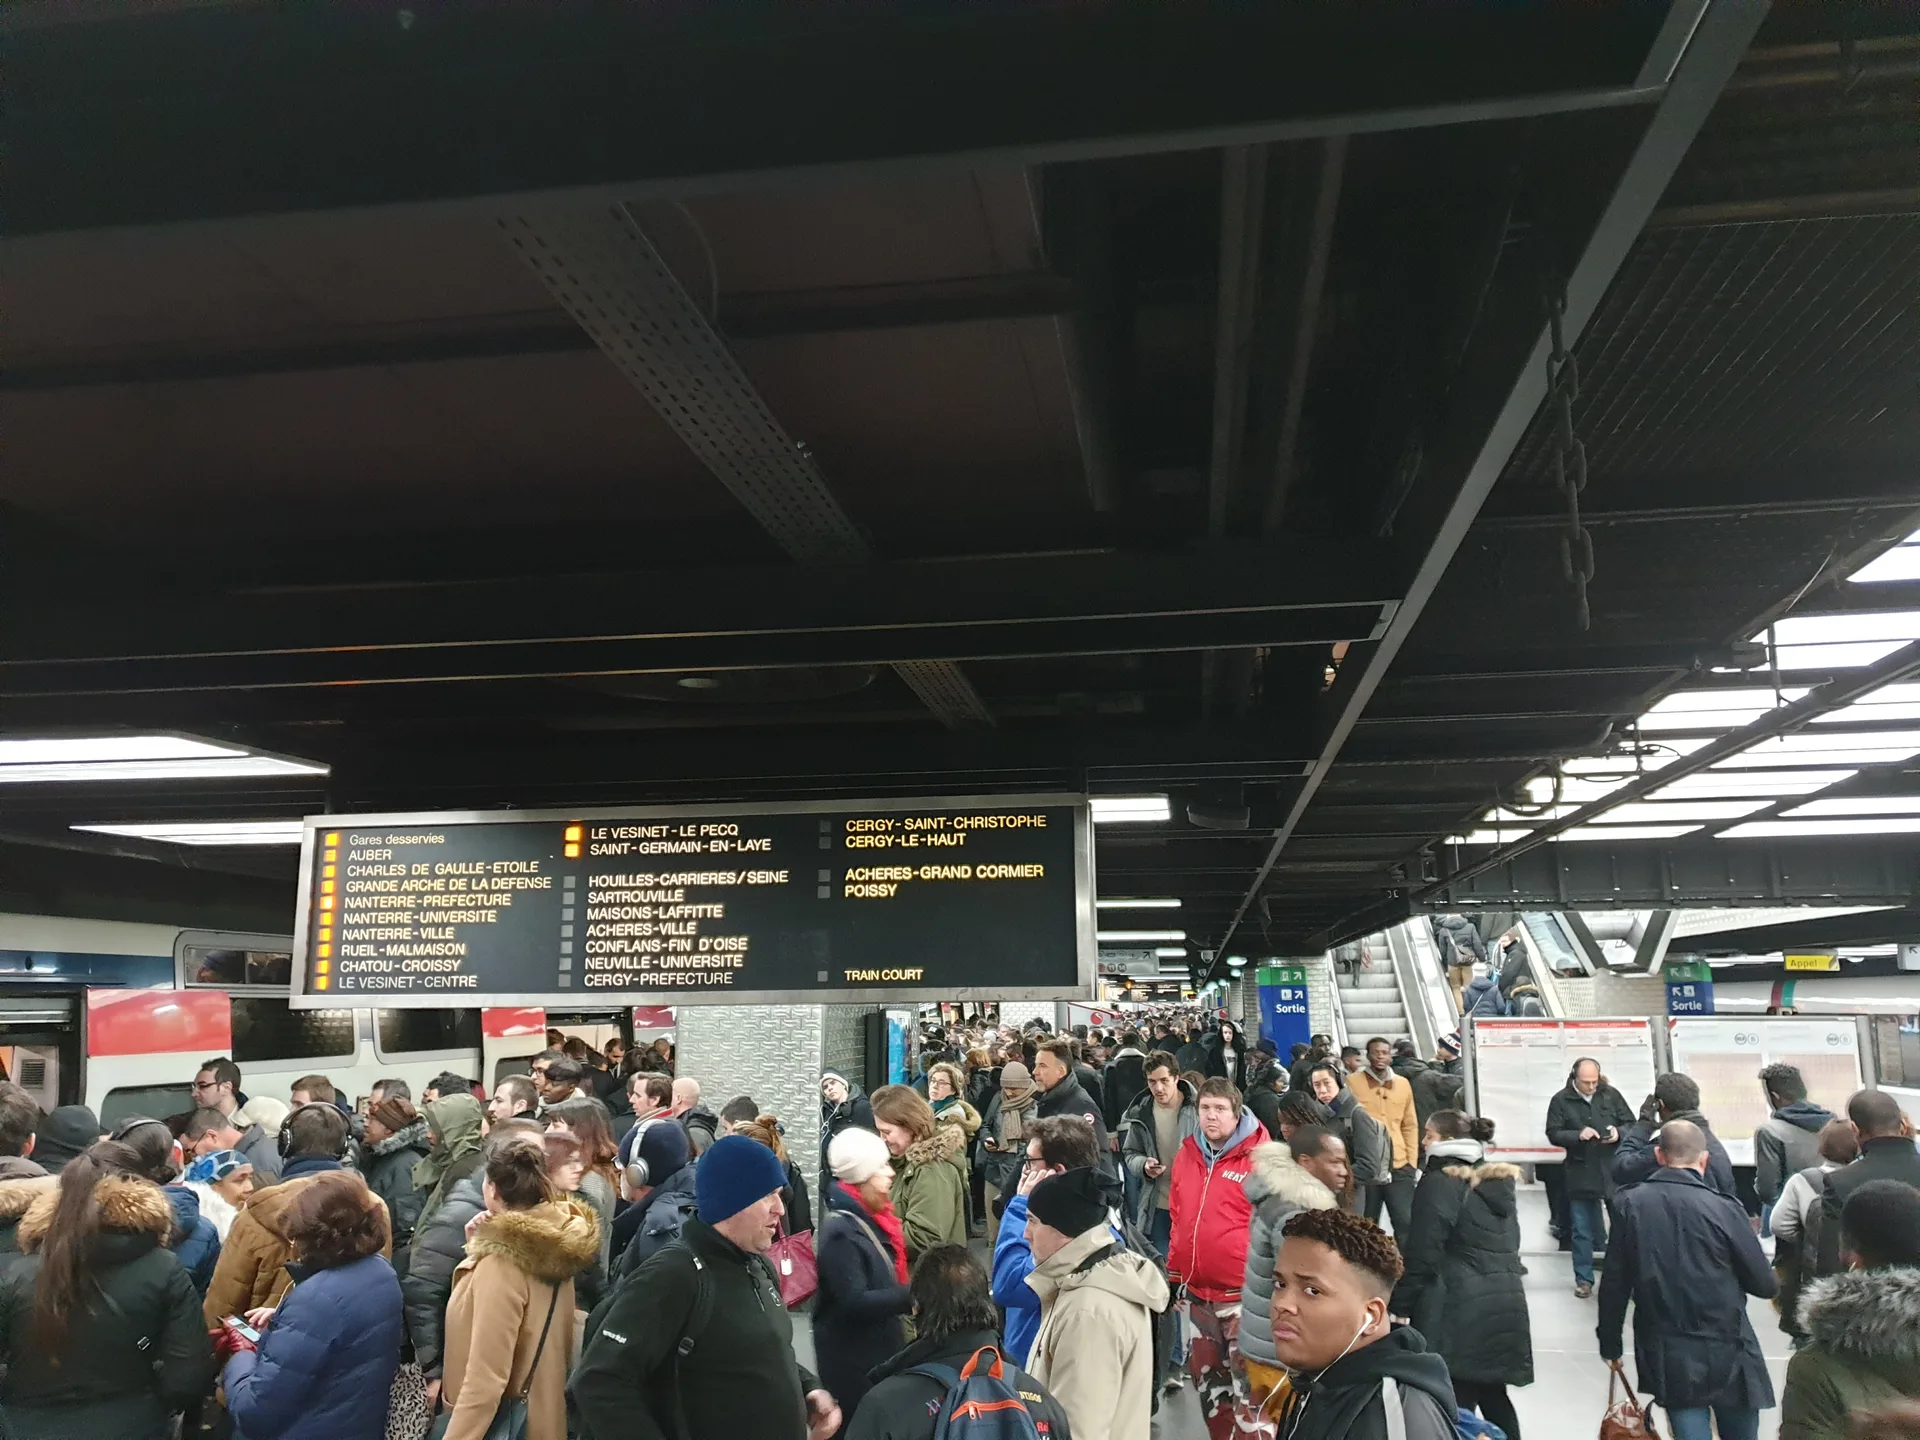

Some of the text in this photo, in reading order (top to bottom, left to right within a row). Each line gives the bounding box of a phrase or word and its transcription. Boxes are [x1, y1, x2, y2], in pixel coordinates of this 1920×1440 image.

[591, 828, 607, 839] LE
[701, 824, 738, 836] PECQ
[350, 832, 445, 846] Gares desservies
[846, 833, 966, 847] CERGY-LE-HAUT
[590, 838, 772, 855] SAINT-GERMAIN-EN-LAYE
[348, 849, 392, 861] AUBER
[347, 861, 539, 877] CHARLES DE GAULLE-ETOILE
[846, 865, 1043, 880] ACHERES-GRAND CORMIER
[345, 877, 552, 893] GRANDE ARCHE DE LA DEFENSE
[589, 871, 788, 887] HOUILLES-CARRIERES/SEINE
[588, 889, 684, 904] SARTROUVILLE
[845, 884, 897, 897] POISSY
[344, 894, 511, 908] NANTERRE-PREFECTURE
[343, 909, 497, 924] NANTERRE-UNIVERSITE
[587, 904, 723, 920] MAISONS-LAFFITTE
[342, 927, 455, 940] NANTERRE-VILLE
[586, 921, 697, 937] ACHERES-VILLE
[341, 943, 466, 957] RUEIL-MALMAISON
[586, 936, 748, 953] CONFLANS-FIN D'OISE
[340, 959, 461, 973] CHATOU-CROISSY
[585, 954, 743, 969] NEUVILLE-UNIVERSITE
[1790, 959, 1818, 969] Appel
[584, 972, 733, 986] CERGY-PREFECTURE
[844, 969, 923, 980] TRAIN COURT
[339, 977, 355, 989] LE
[1275, 1003, 1306, 1014] Sortie
[1671, 1000, 1703, 1011] Sortie
[1221, 1170, 1248, 1184] HEAT
